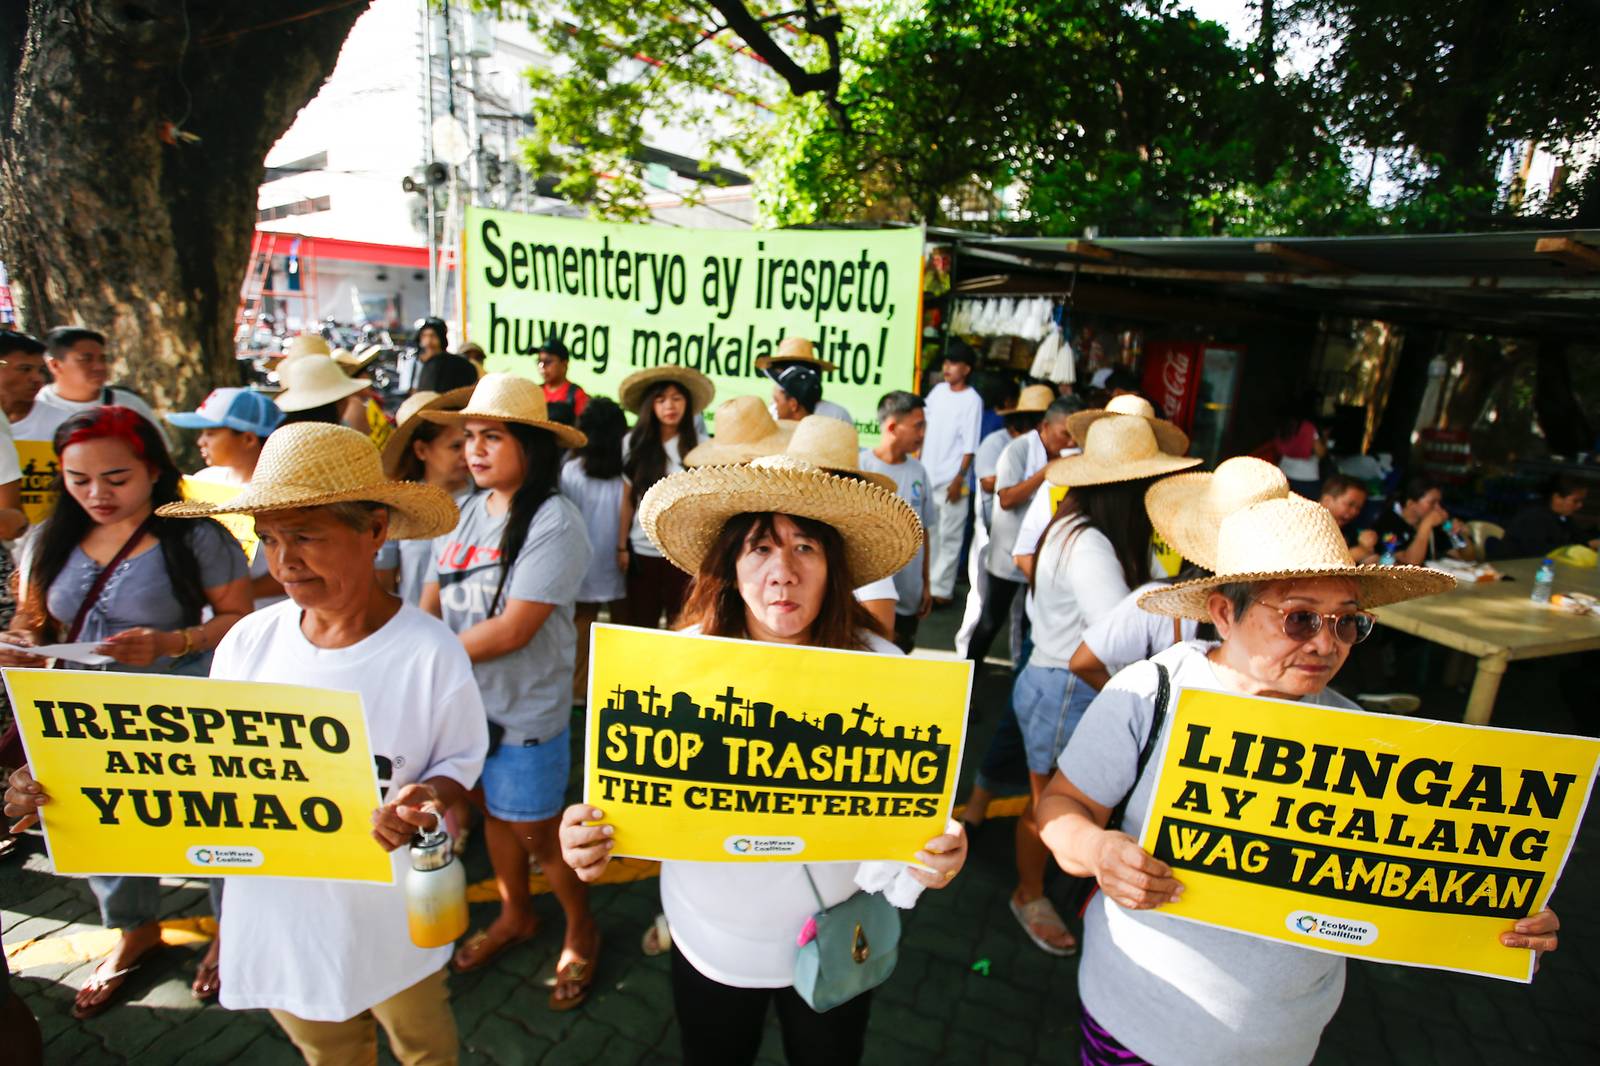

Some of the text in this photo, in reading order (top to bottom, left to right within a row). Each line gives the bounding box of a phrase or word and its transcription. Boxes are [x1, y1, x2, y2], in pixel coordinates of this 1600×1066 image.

[482, 219, 895, 323] Sementeryo ay irespeto,
[34, 700, 351, 754] IRESPETO
[605, 722, 939, 786] STOP TRASHING
[106, 751, 309, 782] ANG MGA
[1178, 723, 1577, 820] LIBINGAN
[81, 787, 343, 834] YUMAO
[598, 774, 939, 818] THE CEMETERIES
[1172, 780, 1550, 862] AY IGALANG
[1169, 824, 1532, 909] WAG TAMBAKAN
[1319, 928, 1362, 940] Coalition
[1322, 920, 1367, 934] EcoWaste
